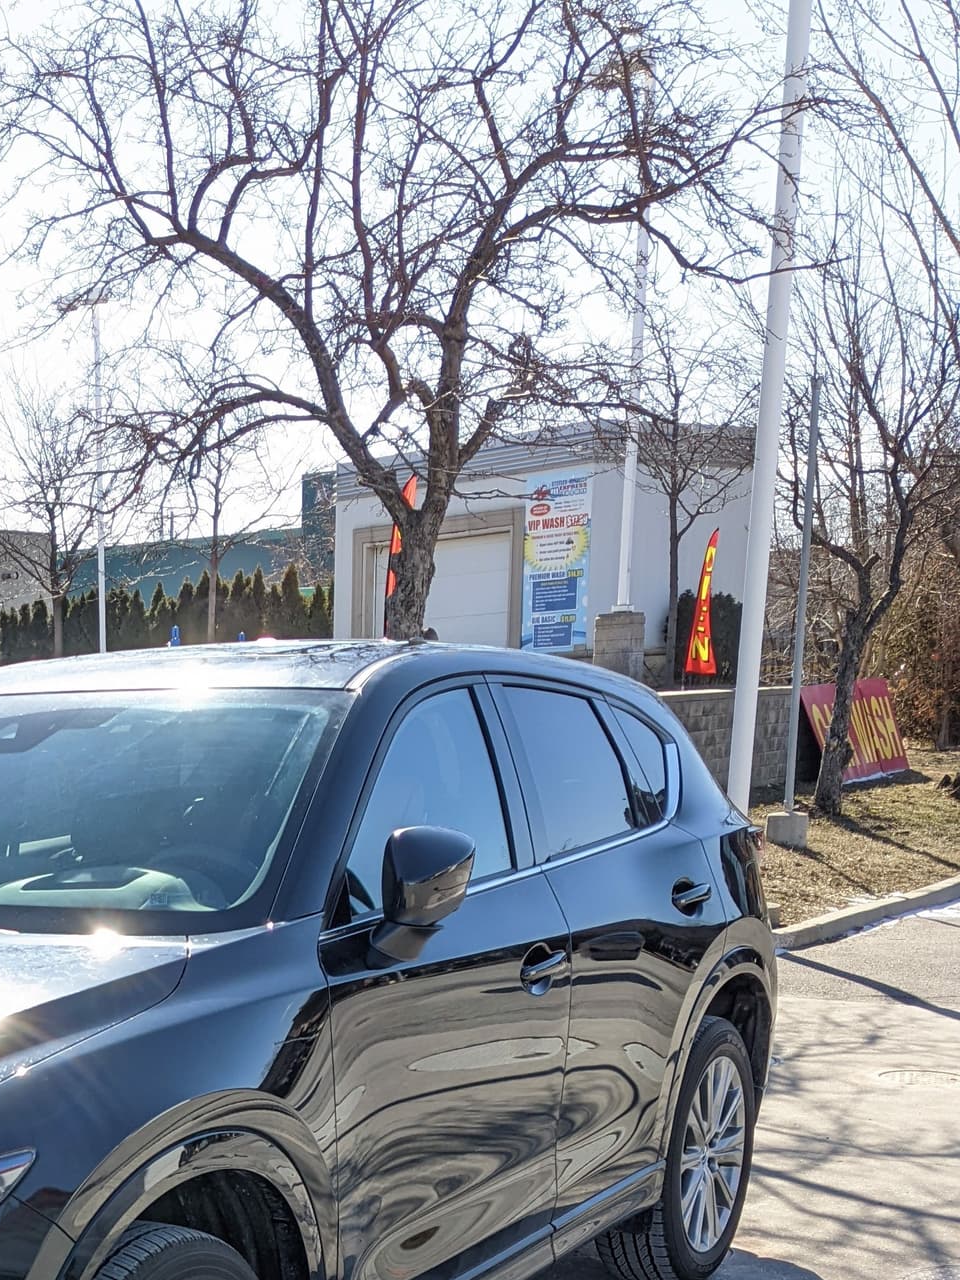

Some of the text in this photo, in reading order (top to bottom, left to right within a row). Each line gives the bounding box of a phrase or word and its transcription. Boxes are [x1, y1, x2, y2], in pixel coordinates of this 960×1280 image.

[528, 519, 540, 531] VIP
[542, 516, 565, 530] WASH
[849, 695, 904, 764] WASH
